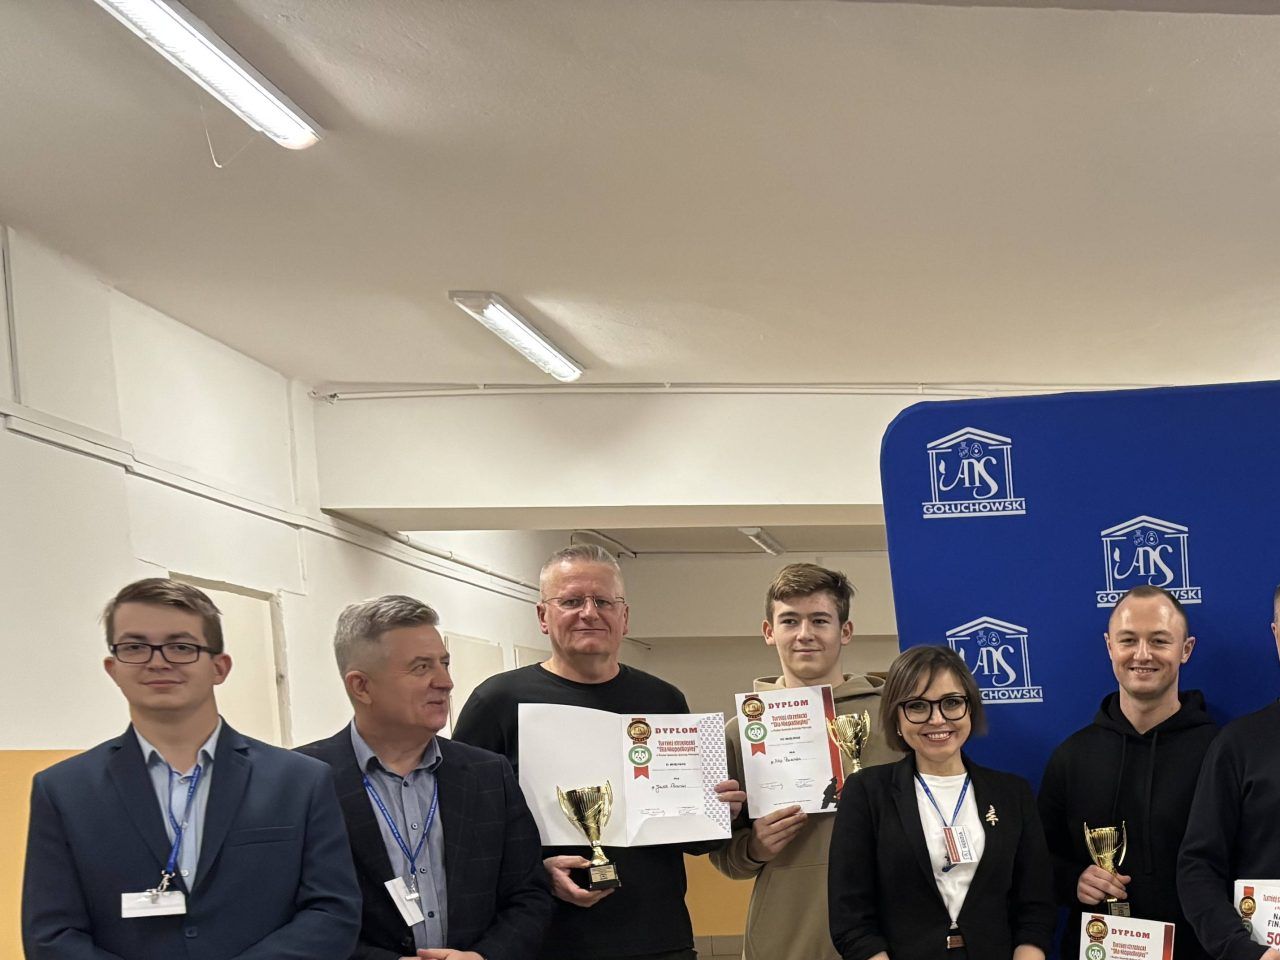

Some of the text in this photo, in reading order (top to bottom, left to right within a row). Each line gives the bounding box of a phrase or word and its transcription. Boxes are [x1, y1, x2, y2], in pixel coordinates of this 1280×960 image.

[923, 501, 1026, 514] GOŁUCHOWSKI
[981, 688, 1043, 700] CHOWSKI
[768, 699, 809, 710] DYPLOM
[1111, 928, 1150, 939] DYPLOM
